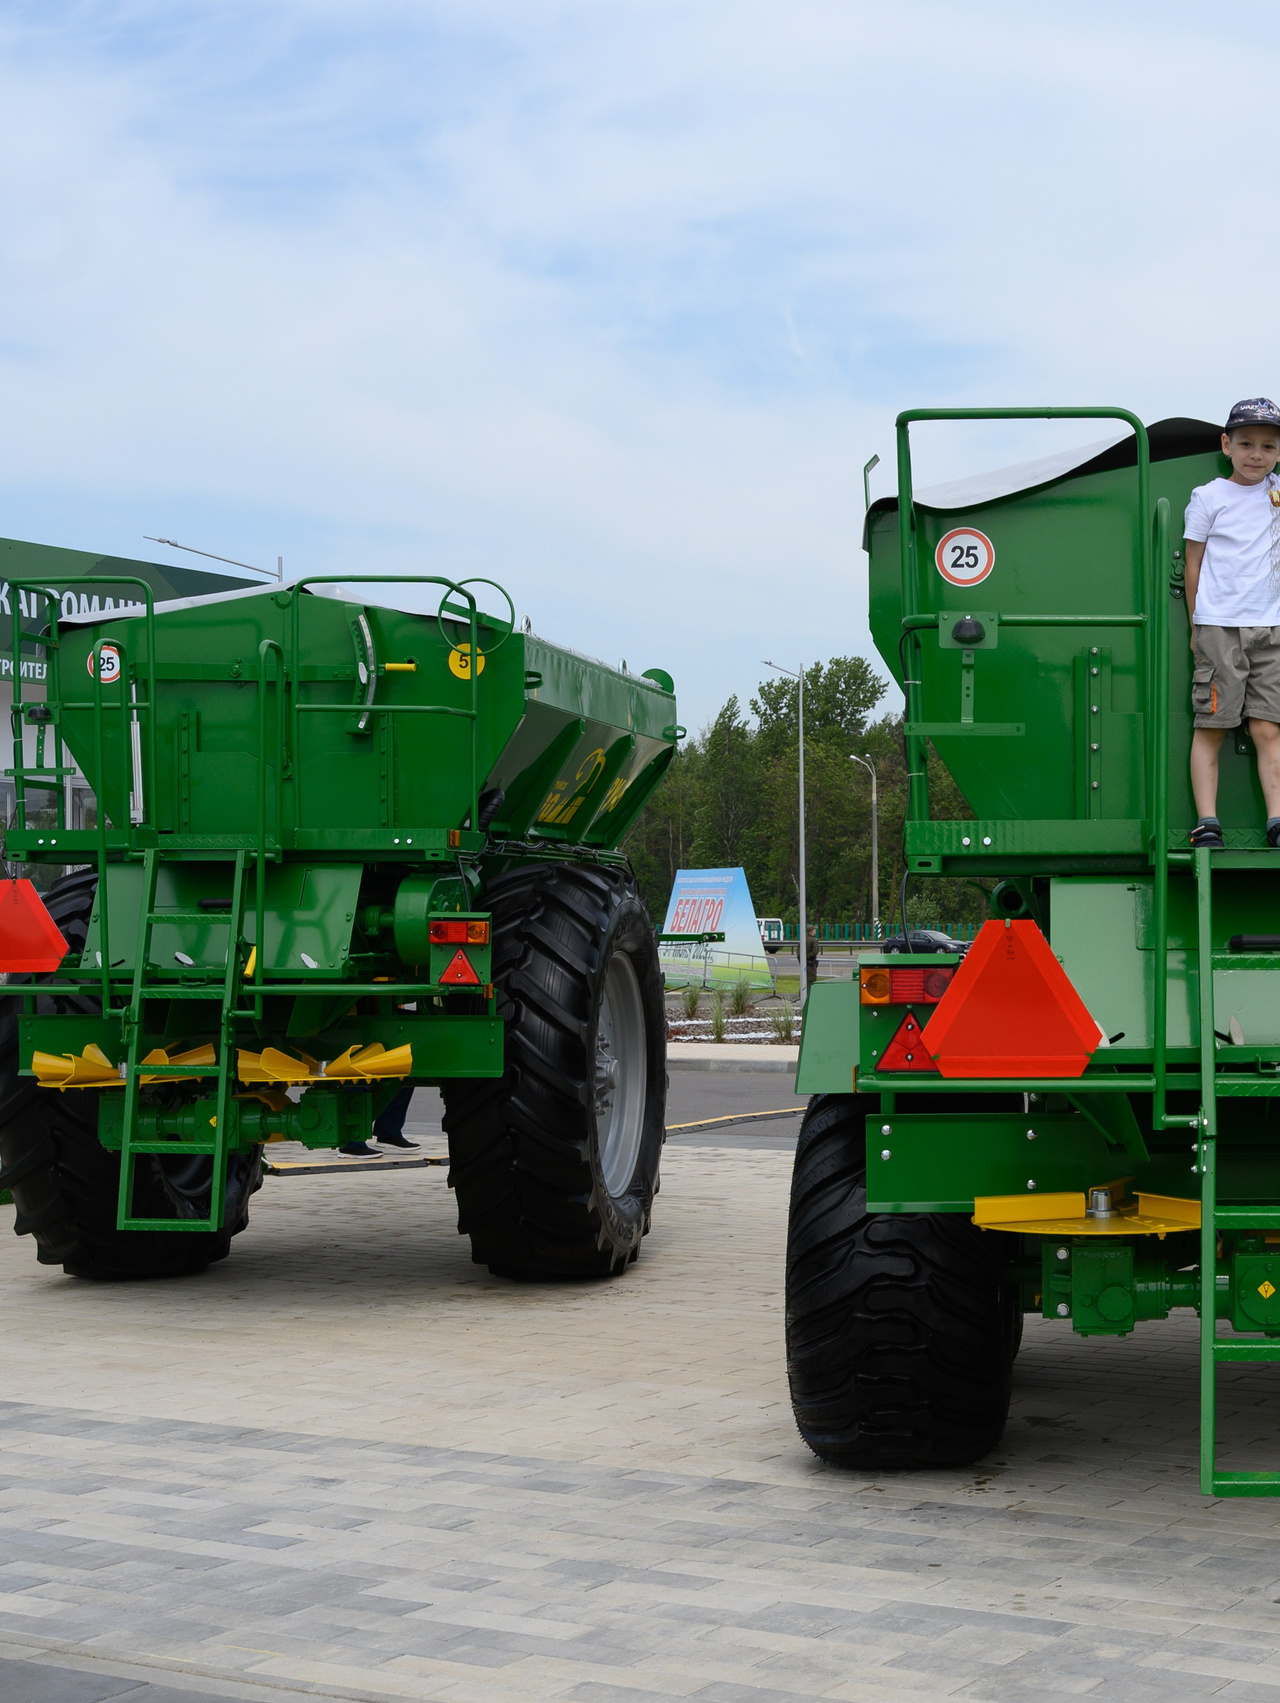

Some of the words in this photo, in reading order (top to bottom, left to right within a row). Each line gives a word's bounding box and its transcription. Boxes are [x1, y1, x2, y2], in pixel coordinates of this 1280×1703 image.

[951, 545, 979, 568] 25
[100, 657, 115, 671] 25
[670, 898, 724, 933] БЕЛАГРО
